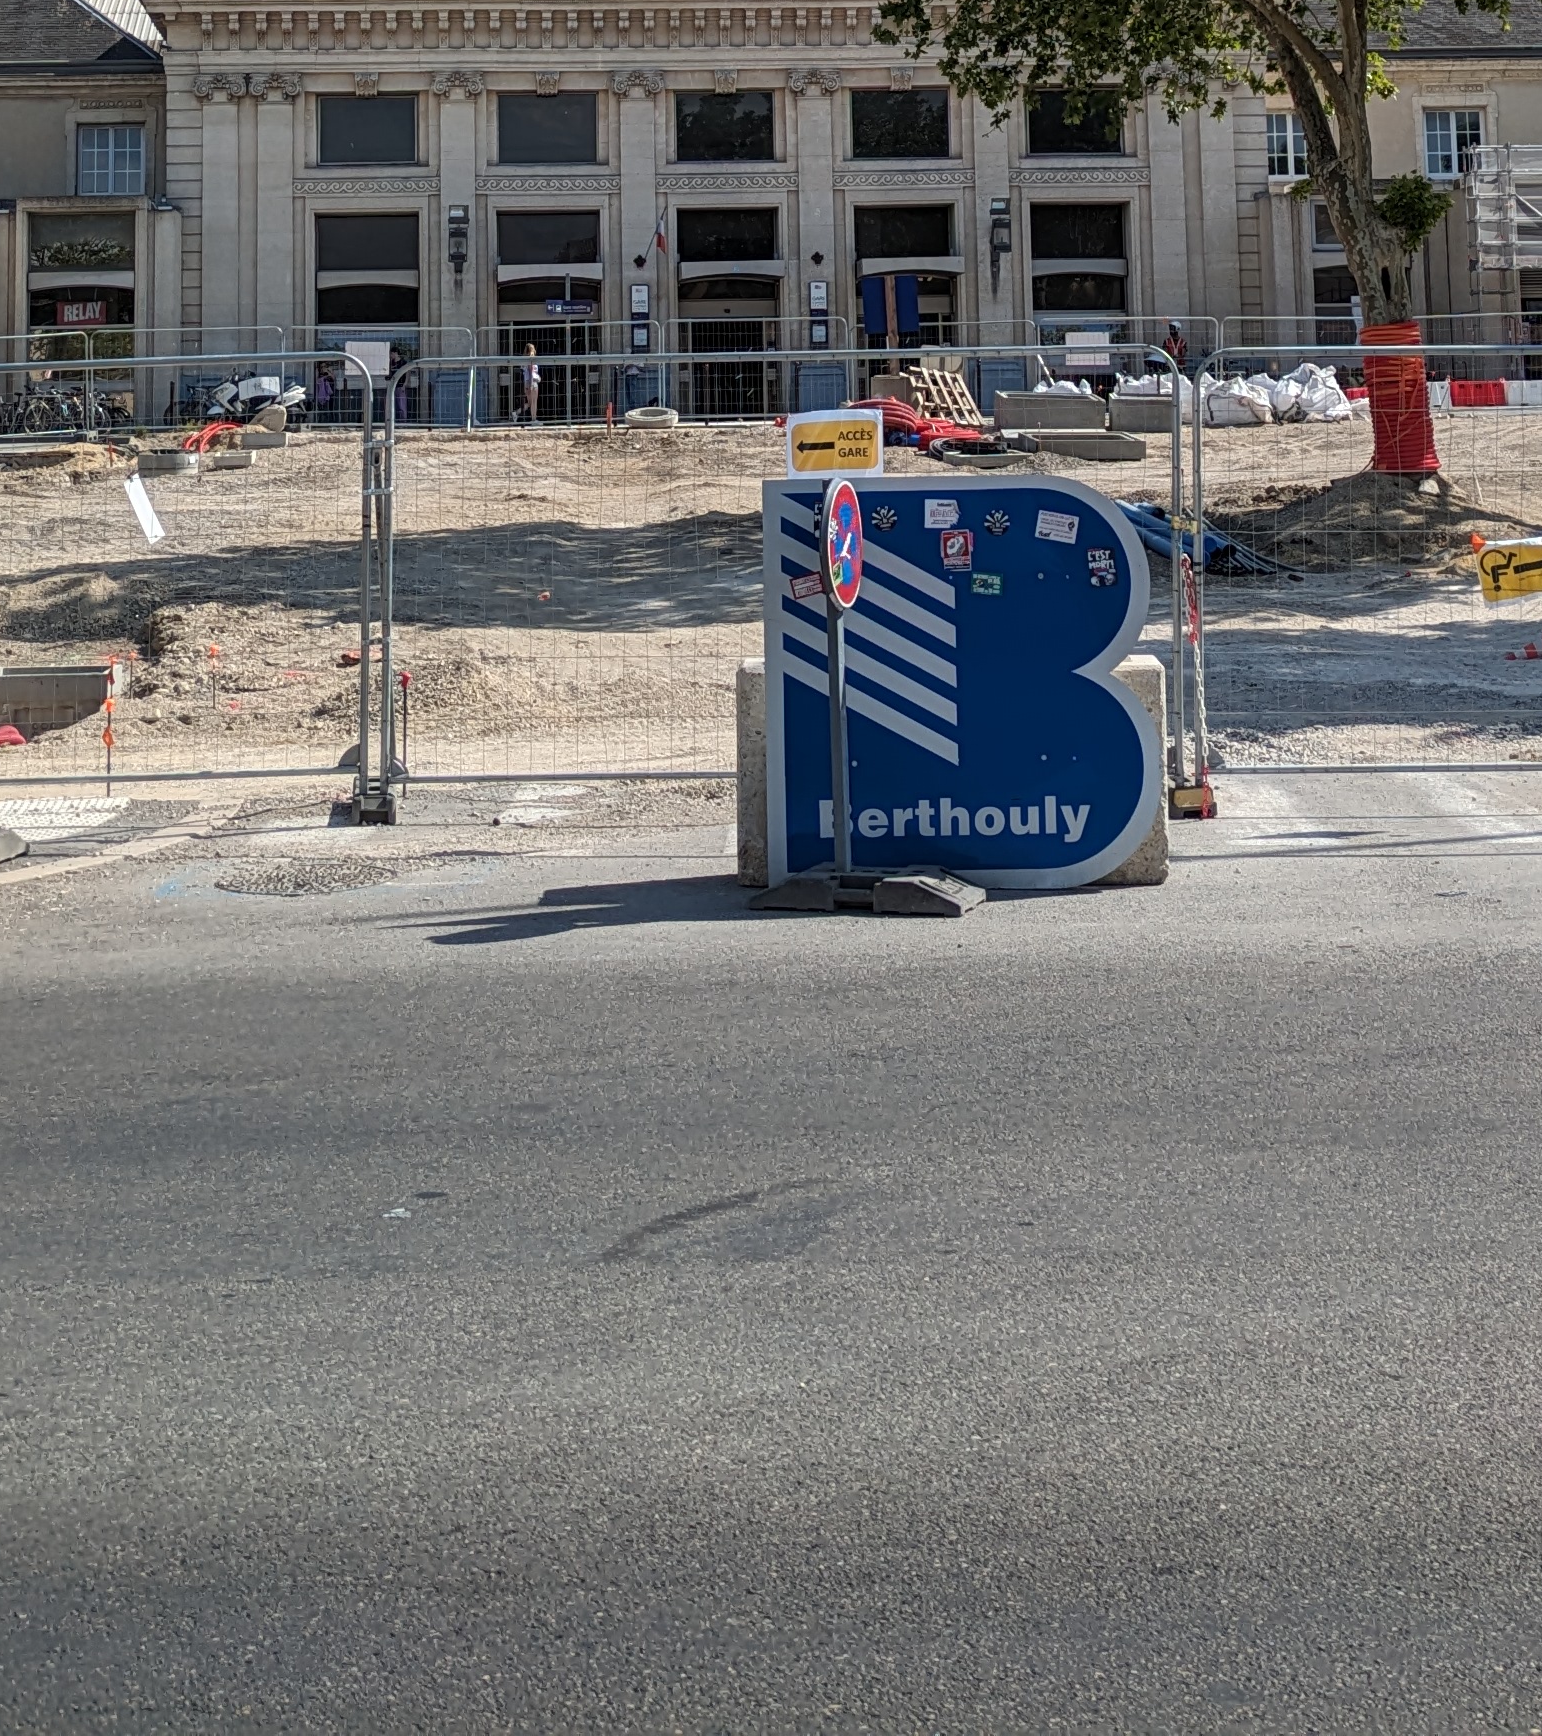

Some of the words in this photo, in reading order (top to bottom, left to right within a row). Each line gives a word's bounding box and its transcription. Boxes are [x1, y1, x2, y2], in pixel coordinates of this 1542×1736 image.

[63, 301, 102, 323] RELAY
[837, 428, 872, 441] ACCÈS
[838, 447, 869, 458] GARE
